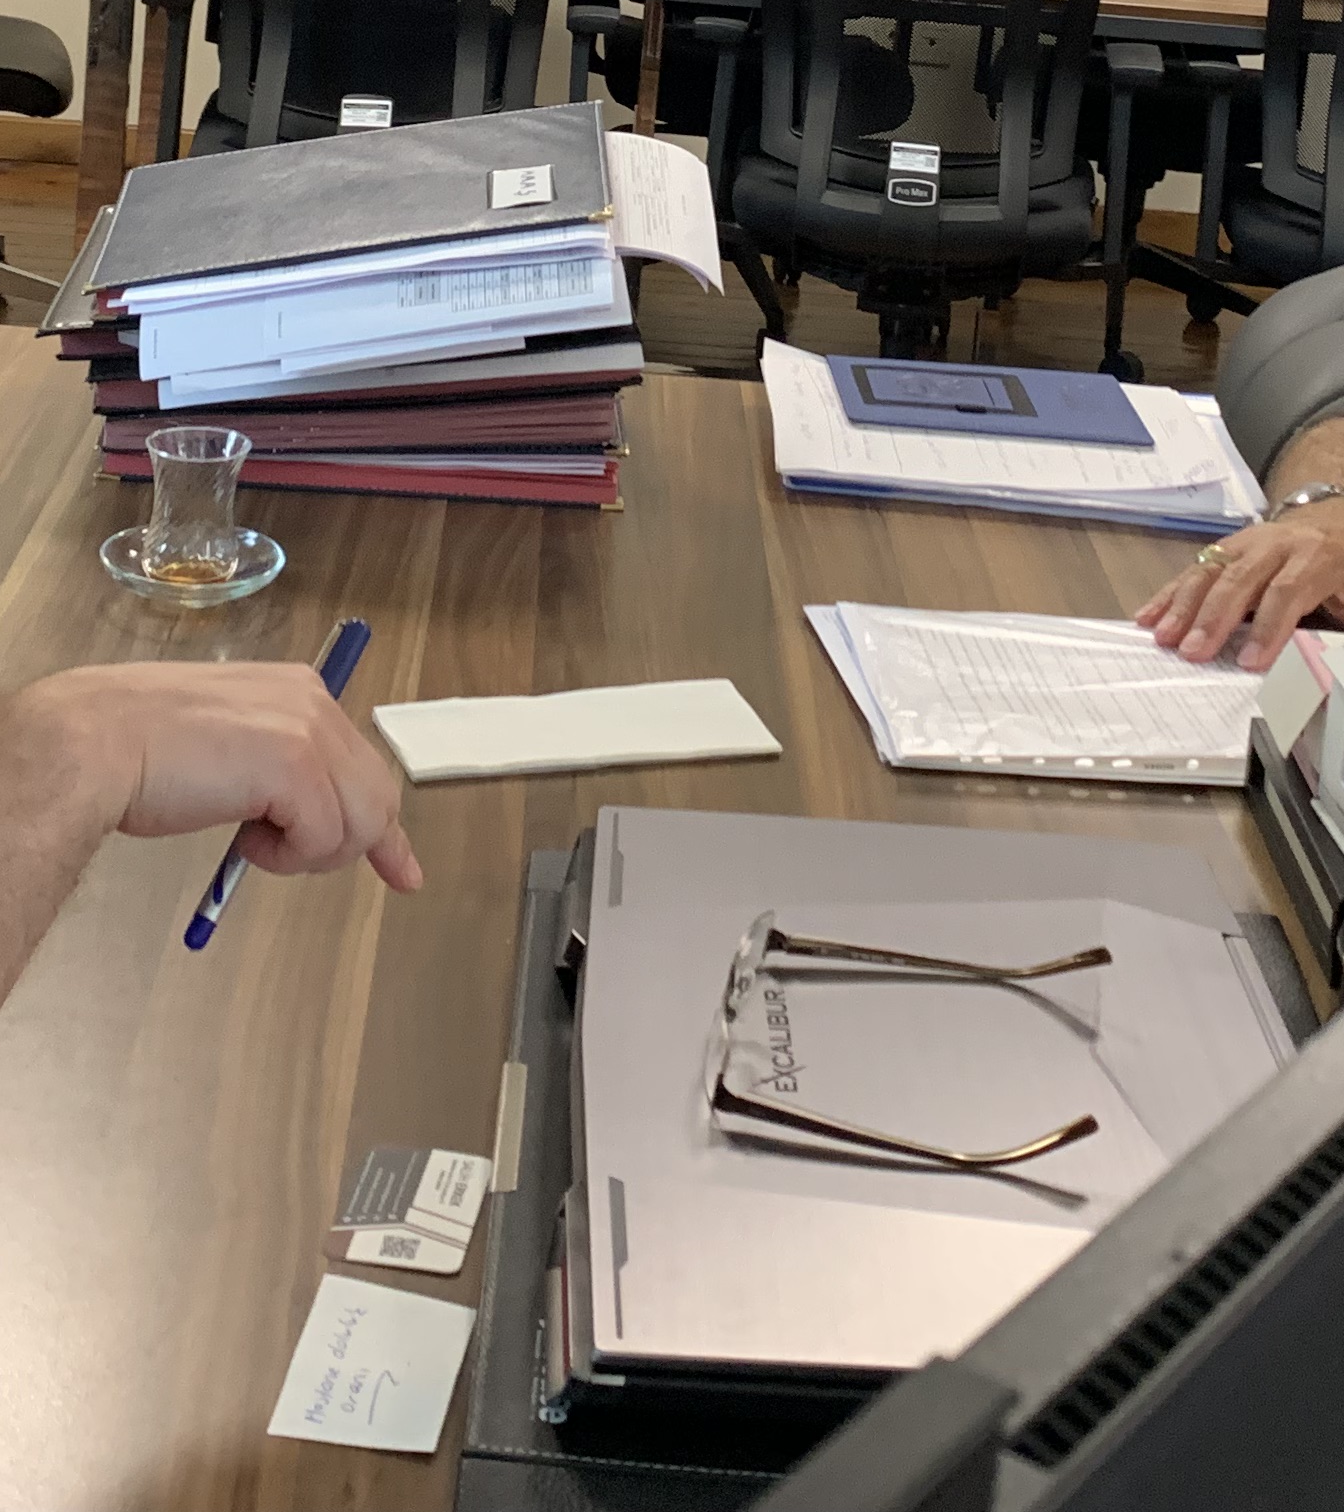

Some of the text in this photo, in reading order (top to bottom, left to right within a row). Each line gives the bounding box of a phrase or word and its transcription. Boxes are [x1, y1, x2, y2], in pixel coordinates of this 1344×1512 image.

[896, 186, 928, 198] Pro Max
[754, 987, 805, 1092] EXCALIBUR
